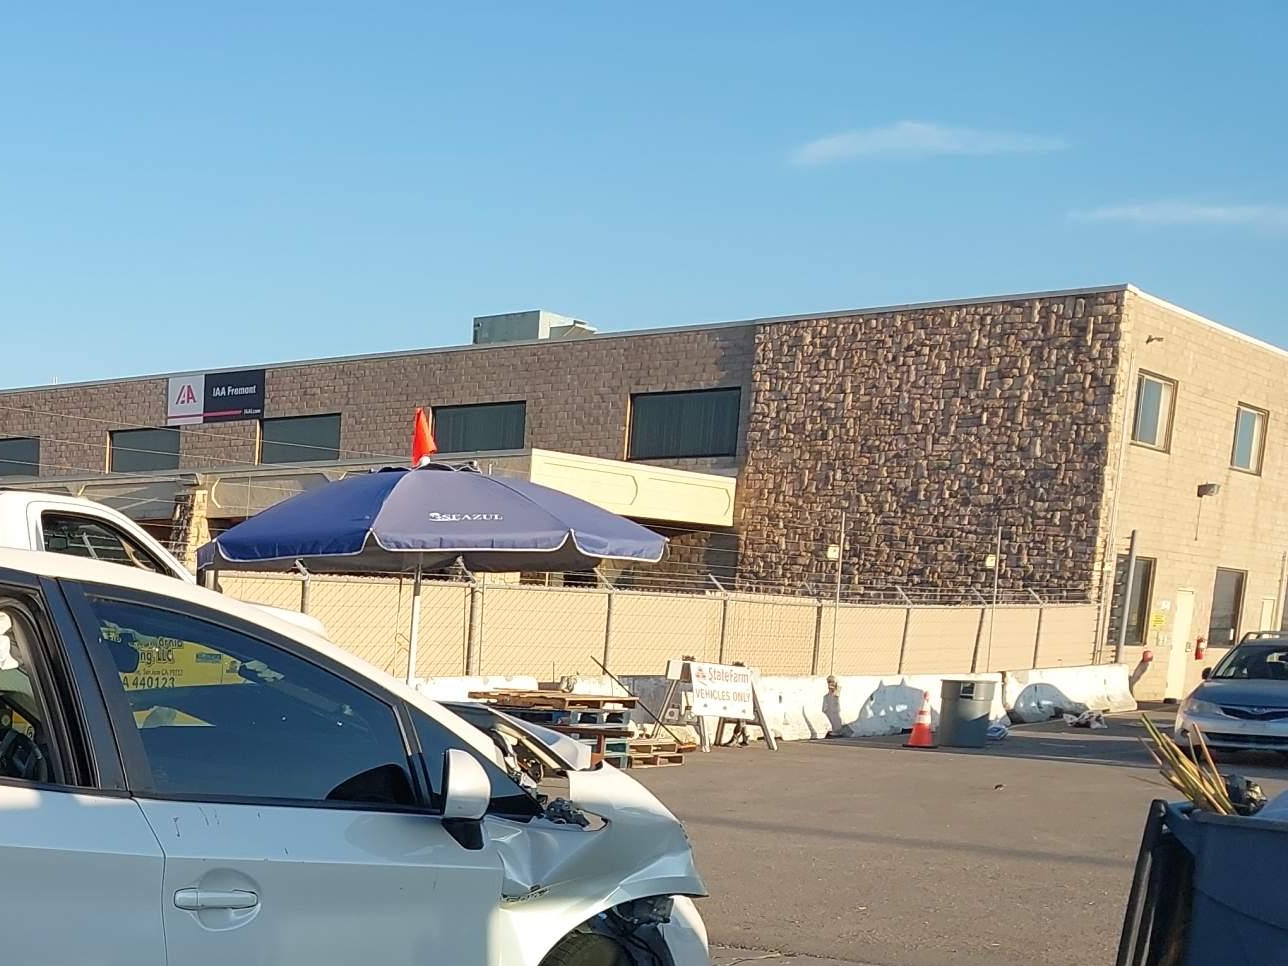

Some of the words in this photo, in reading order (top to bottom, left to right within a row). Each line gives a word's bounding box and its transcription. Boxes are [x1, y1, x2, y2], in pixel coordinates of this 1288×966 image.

[212, 386, 226, 397] IAA
[228, 385, 257, 396] Fremont
[132, 677, 175, 688] 440123
[695, 688, 731, 701] VEHICLES
[732, 691, 751, 703] ONLY
